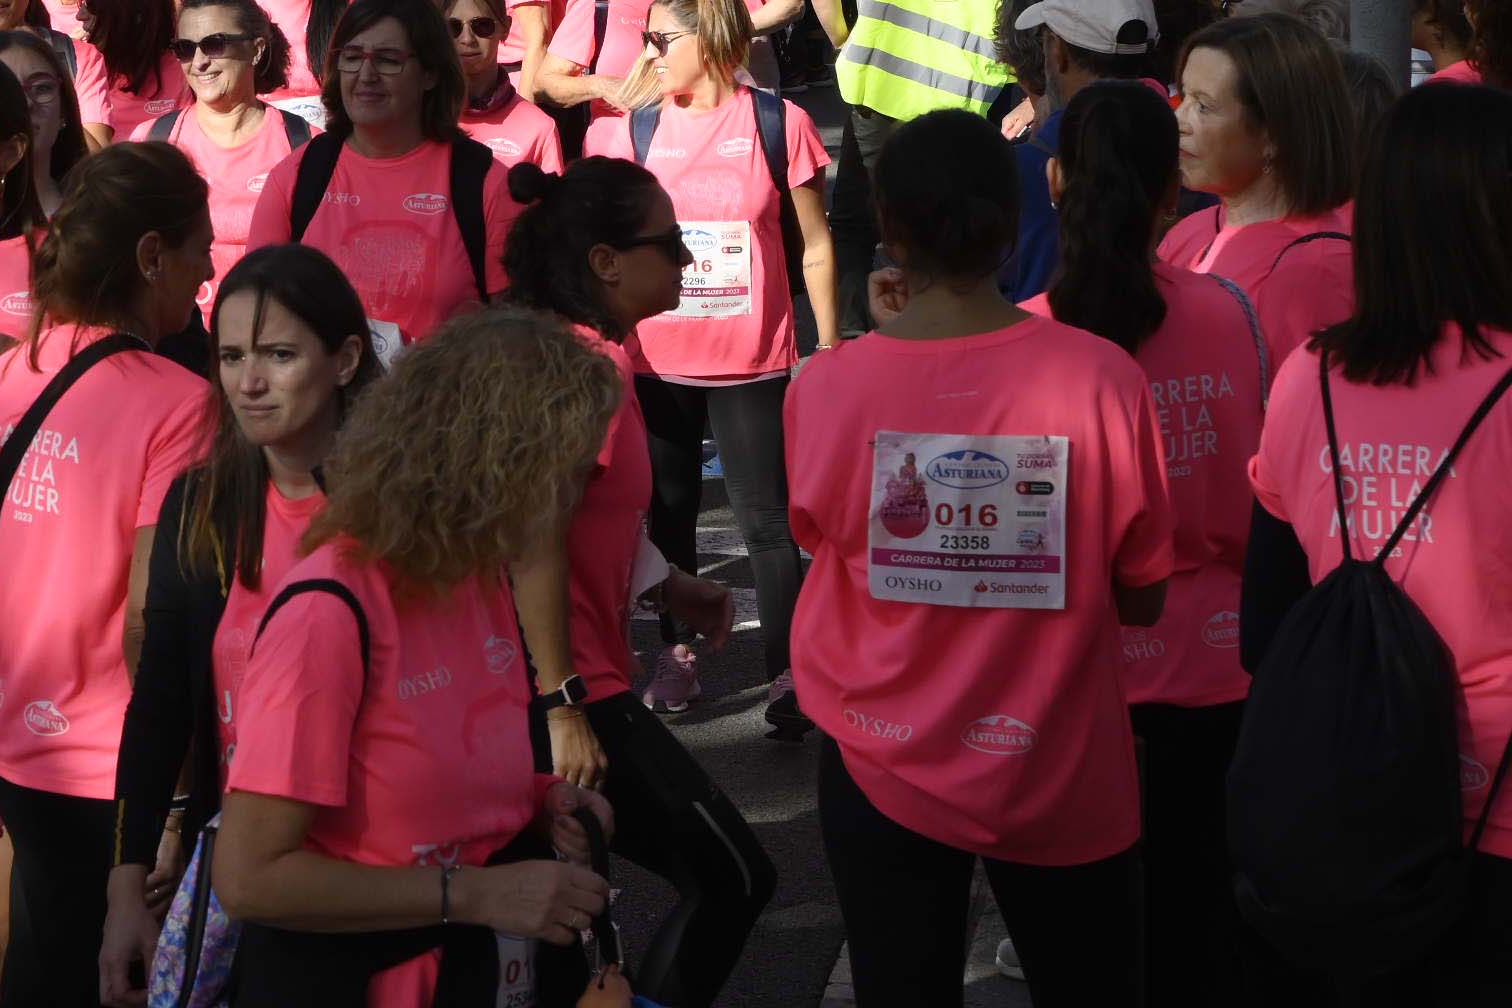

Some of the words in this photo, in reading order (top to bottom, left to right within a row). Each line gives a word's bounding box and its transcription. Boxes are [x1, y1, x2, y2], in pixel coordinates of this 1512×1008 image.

[709, 301, 744, 309] Santander
[1150, 373, 1236, 406] RRERA
[1188, 406, 1213, 429] LA
[1165, 432, 1218, 462] UJER
[32, 456, 56, 487] LA
[932, 462, 1002, 480] ASTURIANA
[1016, 459, 1053, 469] SUMA
[1319, 442, 1457, 480] CARRERA
[6, 479, 60, 515] UJER
[13, 510, 33, 523] 2023
[935, 502, 998, 527] 016
[940, 534, 990, 550] 23358
[890, 553, 942, 565] CARRERA
[943, 556, 959, 567] DE
[961, 558, 976, 568] LA
[978, 559, 1016, 569] MUJER
[1020, 558, 1047, 569] 2023
[885, 575, 942, 592] OYSHO
[990, 581, 1050, 594] Santander
[398, 667, 454, 701] OYSHO
[843, 709, 913, 742] OYSHO
[969, 726, 1032, 747] ASTURIANA
